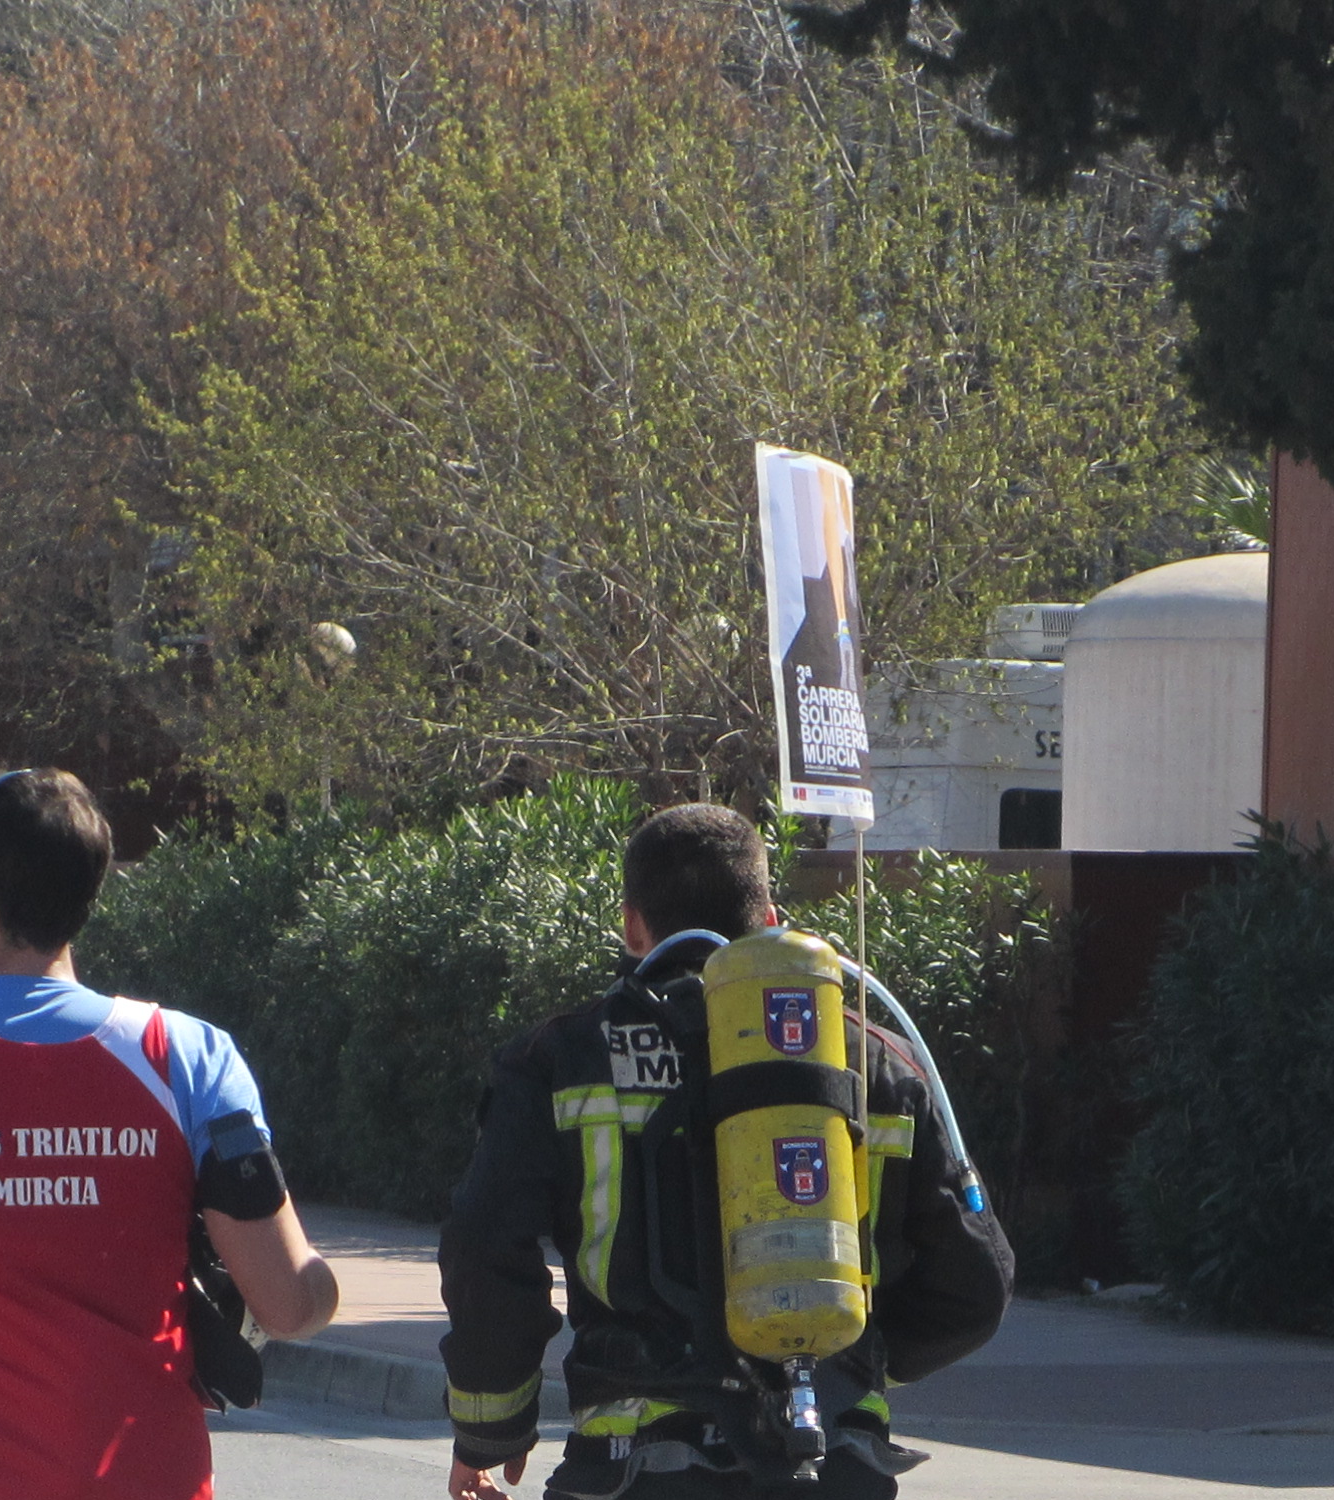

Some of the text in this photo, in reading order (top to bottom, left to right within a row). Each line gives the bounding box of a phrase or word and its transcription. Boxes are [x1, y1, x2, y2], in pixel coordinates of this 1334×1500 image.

[797, 685, 861, 712] CARRERA
[799, 704, 867, 731] SOLIDARIA
[803, 744, 861, 769] MURCIA
[1035, 729, 1062, 758] SE
[609, 1027, 671, 1056] BO
[635, 1053, 678, 1085] M
[11, 1127, 158, 1157] TRIATLON
